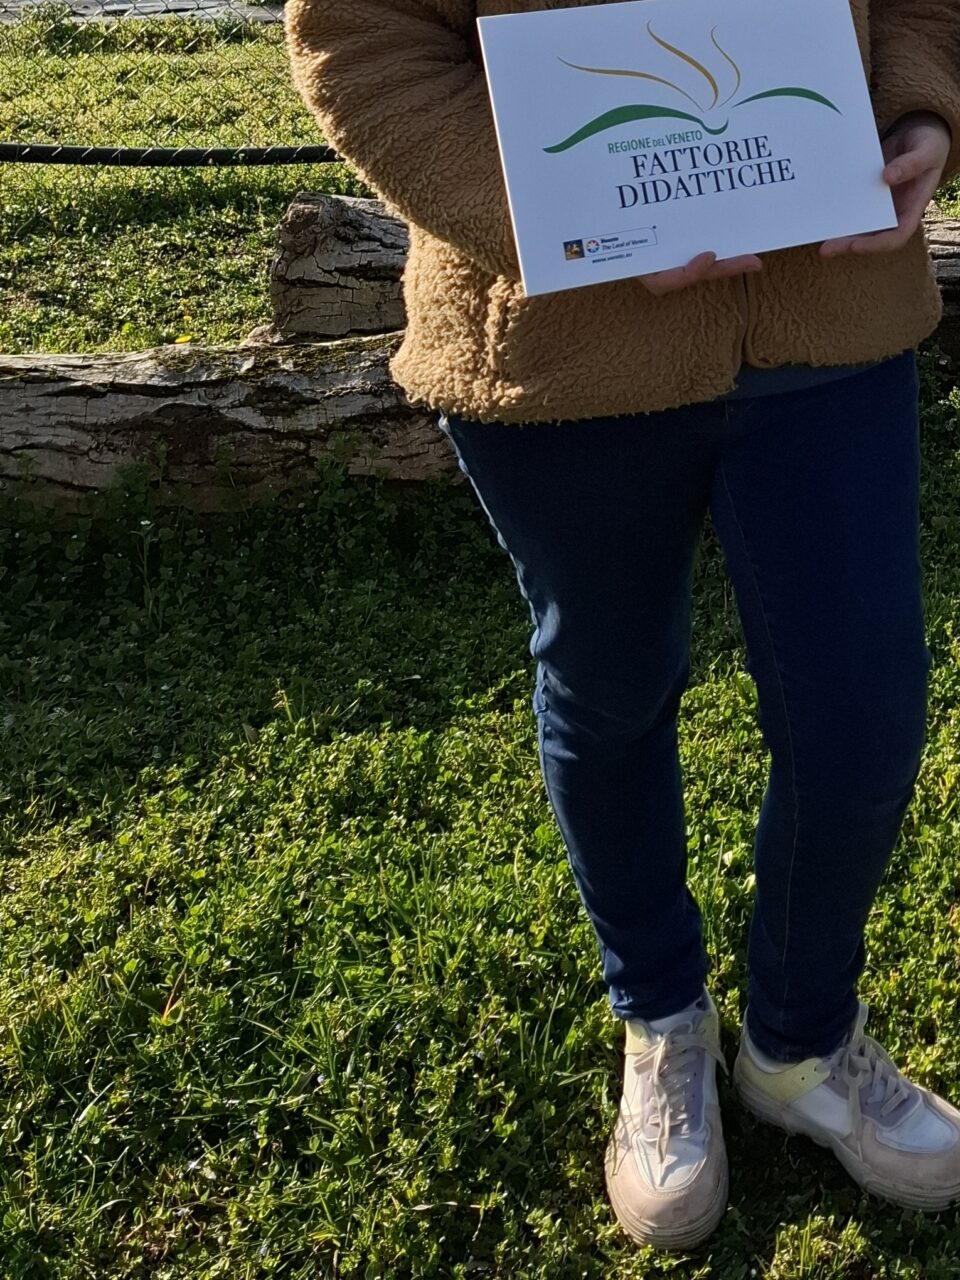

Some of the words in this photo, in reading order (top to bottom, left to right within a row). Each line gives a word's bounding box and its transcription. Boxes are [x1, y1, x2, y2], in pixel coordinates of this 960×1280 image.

[608, 136, 652, 154] REGIONE
[652, 137, 666, 148] DEL
[665, 129, 703, 145] VENETO
[630, 135, 772, 179] FATTORIE
[616, 158, 795, 209] DIDATTICHE
